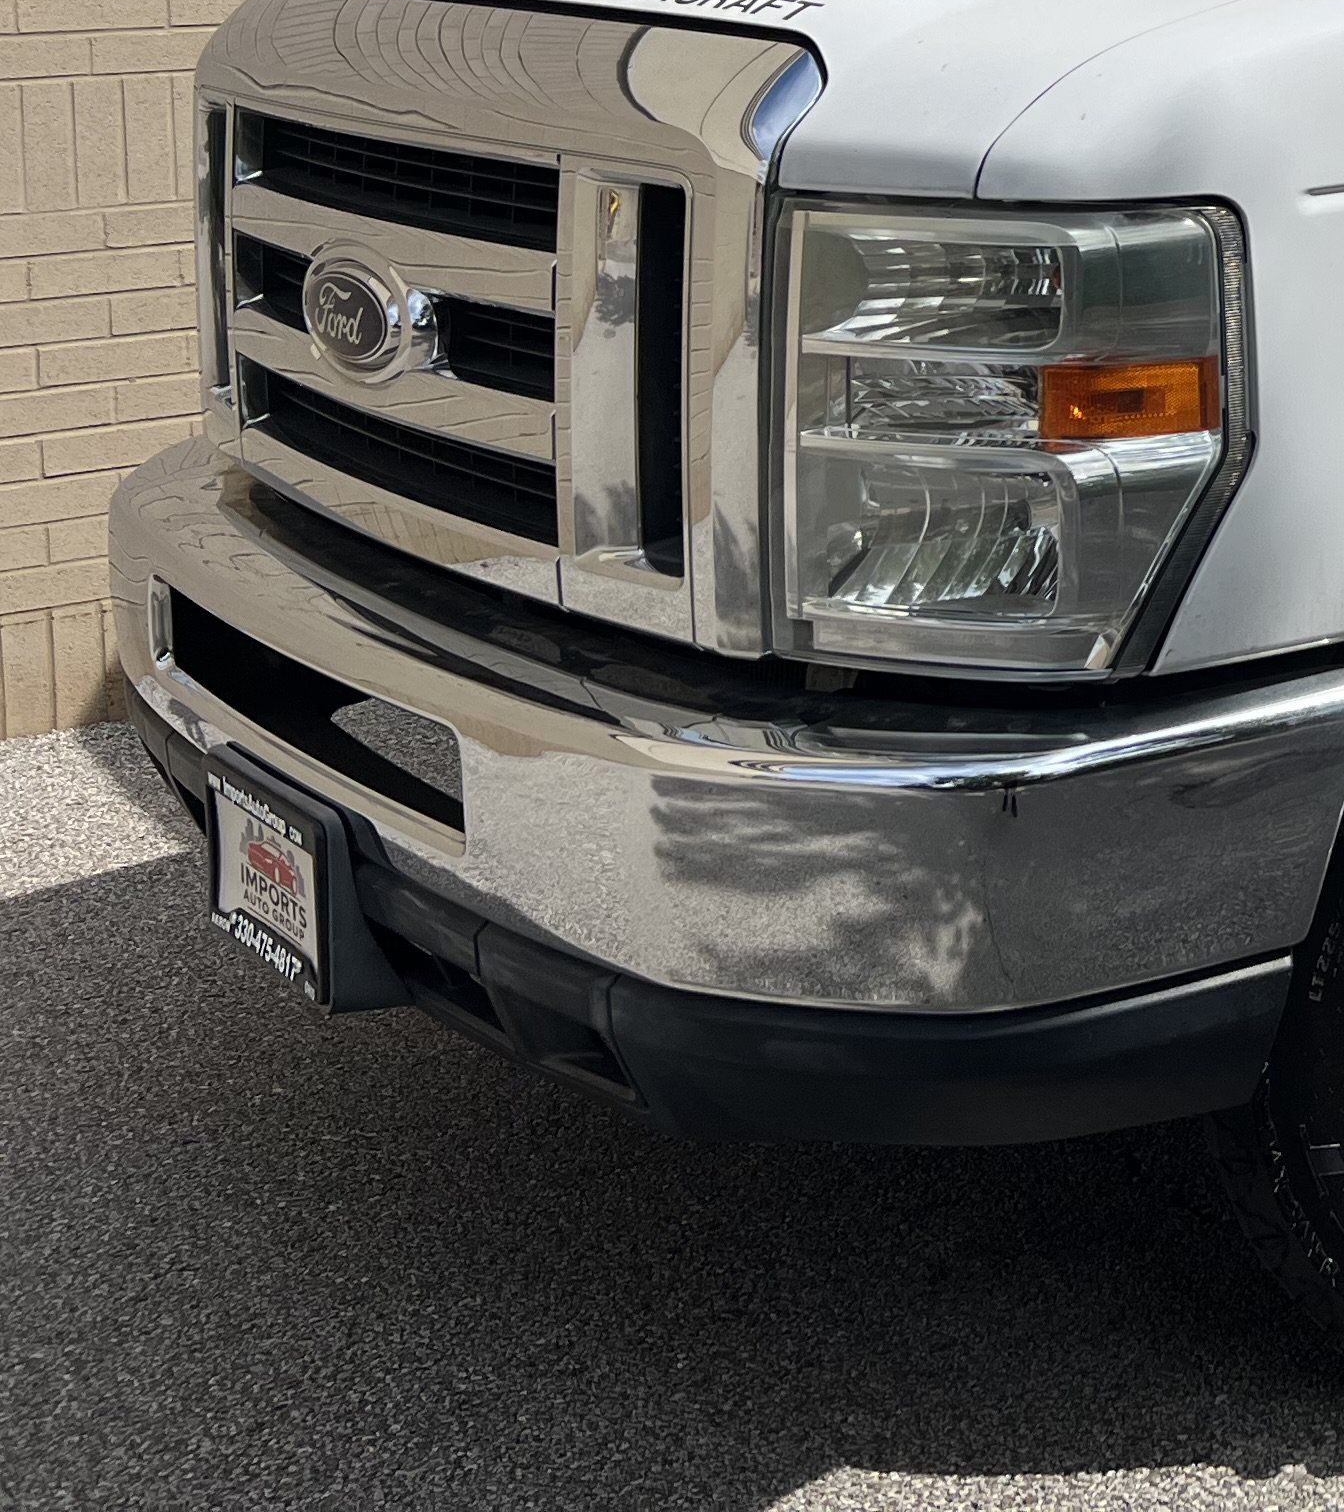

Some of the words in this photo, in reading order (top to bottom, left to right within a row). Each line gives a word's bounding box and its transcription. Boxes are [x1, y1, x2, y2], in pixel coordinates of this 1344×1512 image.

[315, 282, 364, 345] Ford
[241, 863, 307, 929] IMPORTS
[243, 888, 270, 915] AUTO
[272, 908, 305, 940] GROUP
